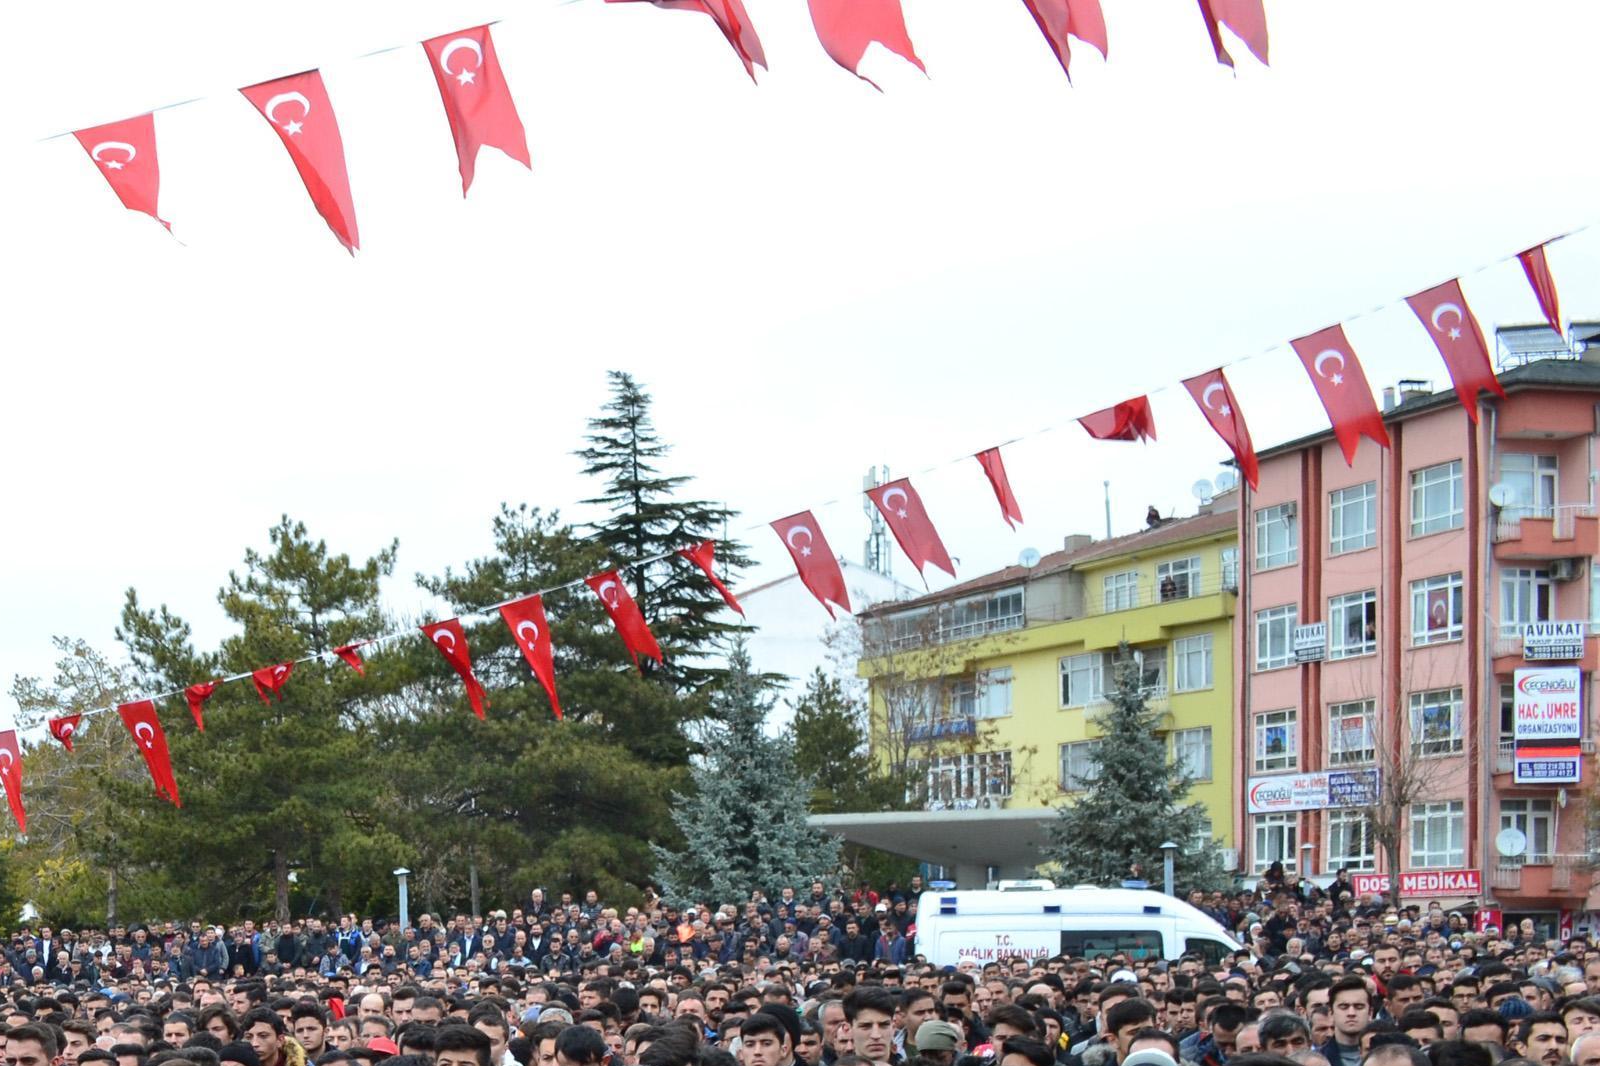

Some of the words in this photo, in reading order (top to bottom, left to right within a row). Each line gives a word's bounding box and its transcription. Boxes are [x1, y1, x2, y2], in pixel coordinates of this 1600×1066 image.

[1295, 625, 1325, 640] AVUKAT
[1526, 623, 1581, 637] AVUKAT
[1518, 703, 1539, 719] HAC
[1547, 702, 1577, 719] UMRE
[1360, 877, 1391, 891] DOS
[1403, 871, 1478, 890] MEDİKAL
[995, 935, 1013, 946] T.C.
[958, 947, 994, 959] SAĞLIK
[997, 946, 1050, 960] BAKANLIĞI
